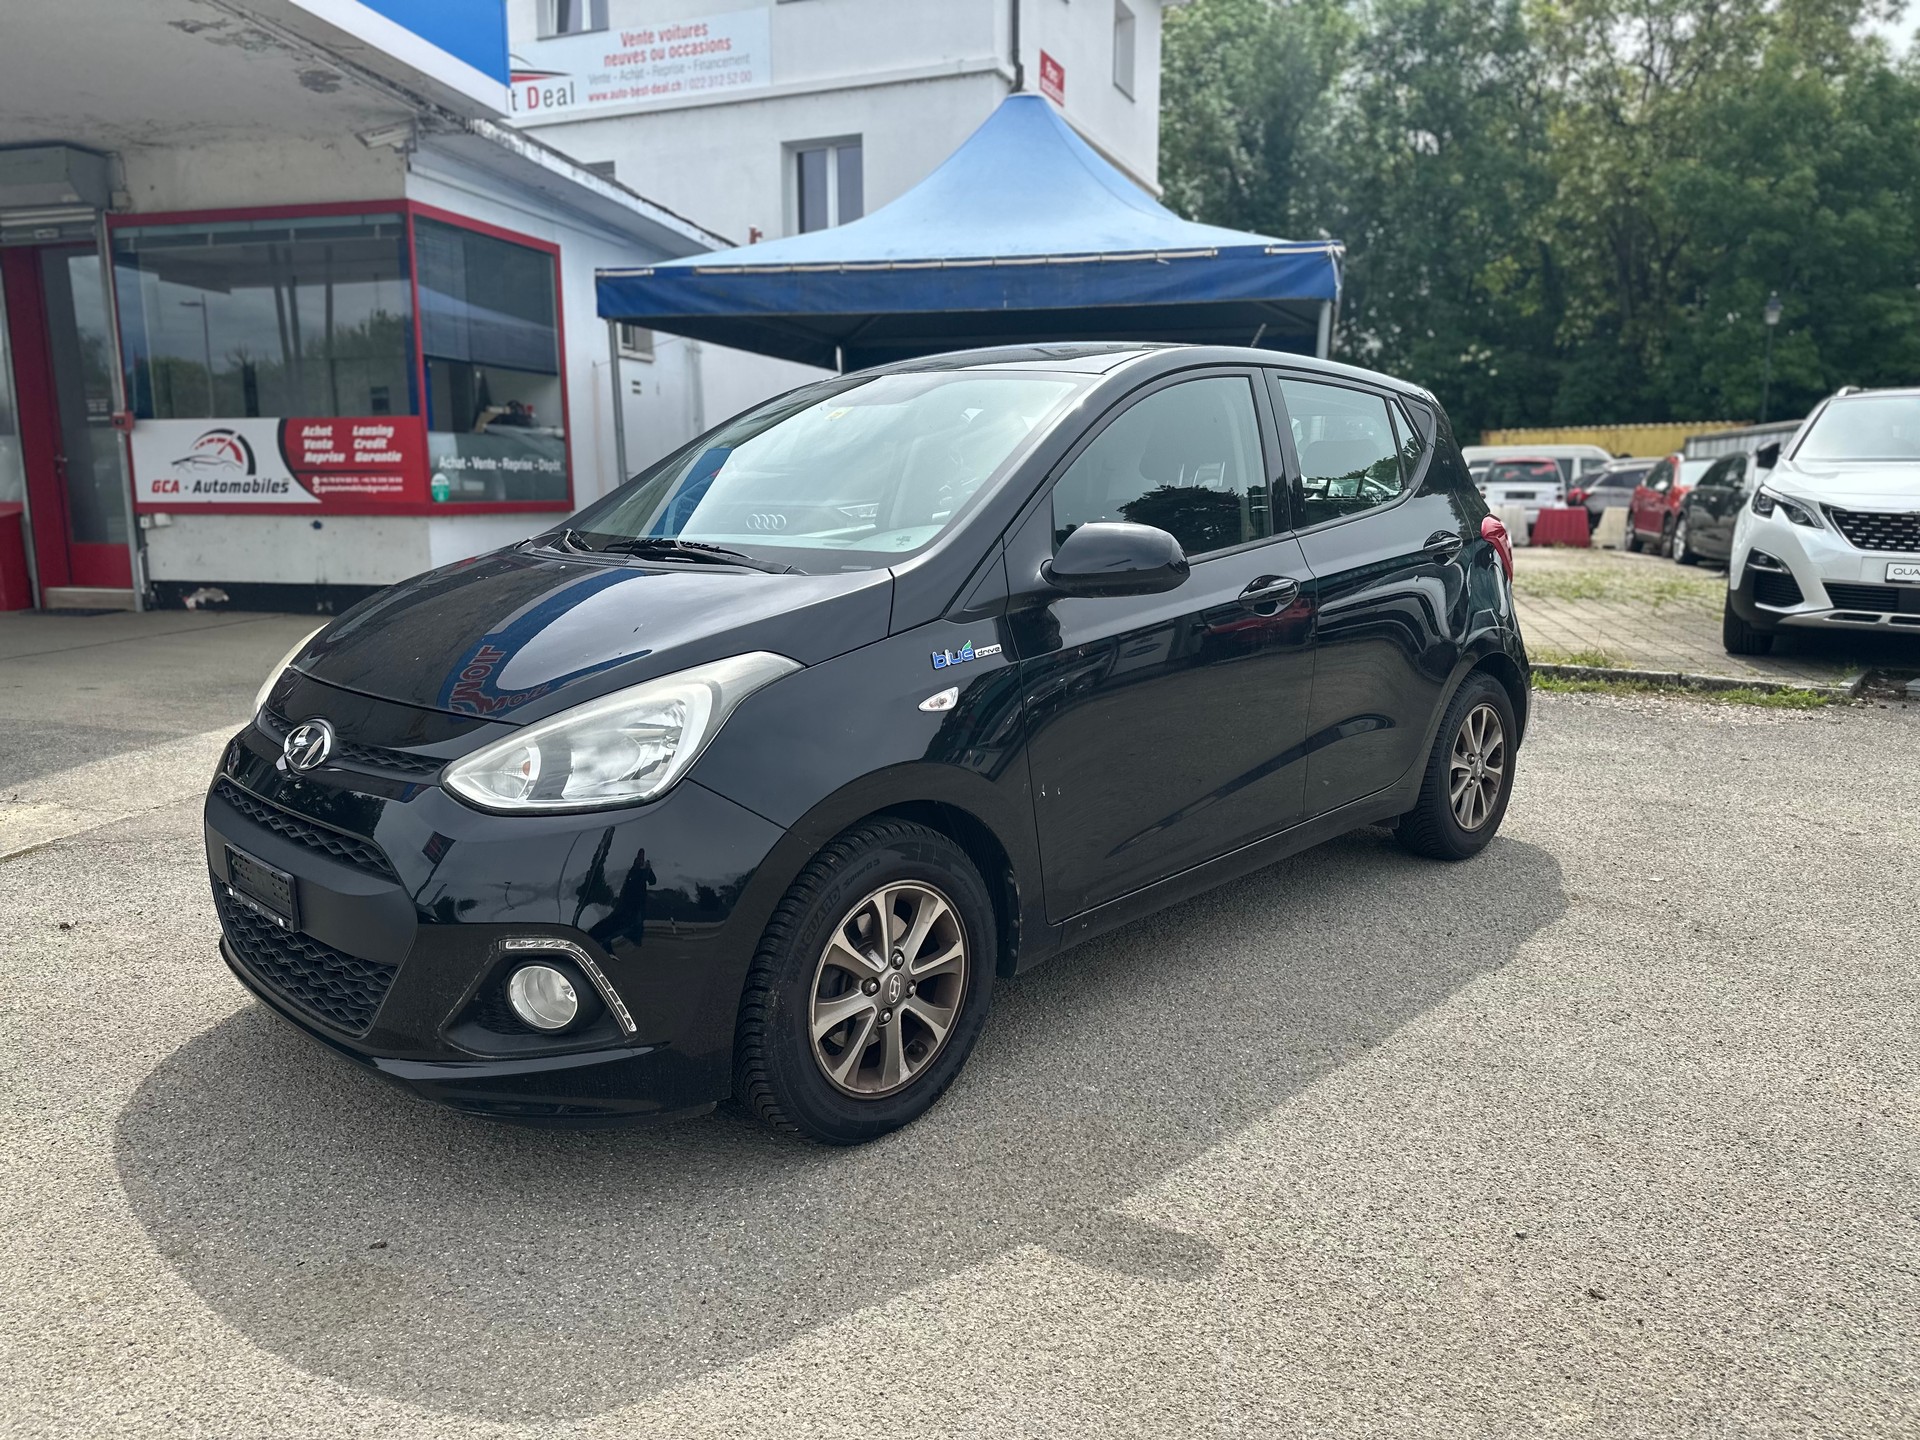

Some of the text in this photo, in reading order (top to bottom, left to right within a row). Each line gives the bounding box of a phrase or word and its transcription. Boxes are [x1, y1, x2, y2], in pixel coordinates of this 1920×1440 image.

[621, 23, 708, 48] Vente voitures
[604, 37, 732, 67] neuves ou occasions
[651, 62, 686, 79] Reprise
[693, 53, 750, 72] Financement
[527, 80, 575, 110] Deal
[302, 425, 333, 437] Achat
[352, 424, 394, 439] Leasing
[303, 438, 334, 450] Vente
[304, 451, 346, 465] Reprise
[354, 450, 402, 462] Garantie
[438, 456, 466, 470] Achat
[471, 455, 497, 470] Vente
[502, 457, 533, 473] Reprise
[151, 478, 290, 494] GCA Automobiles
[977, 645, 1001, 657] drive
